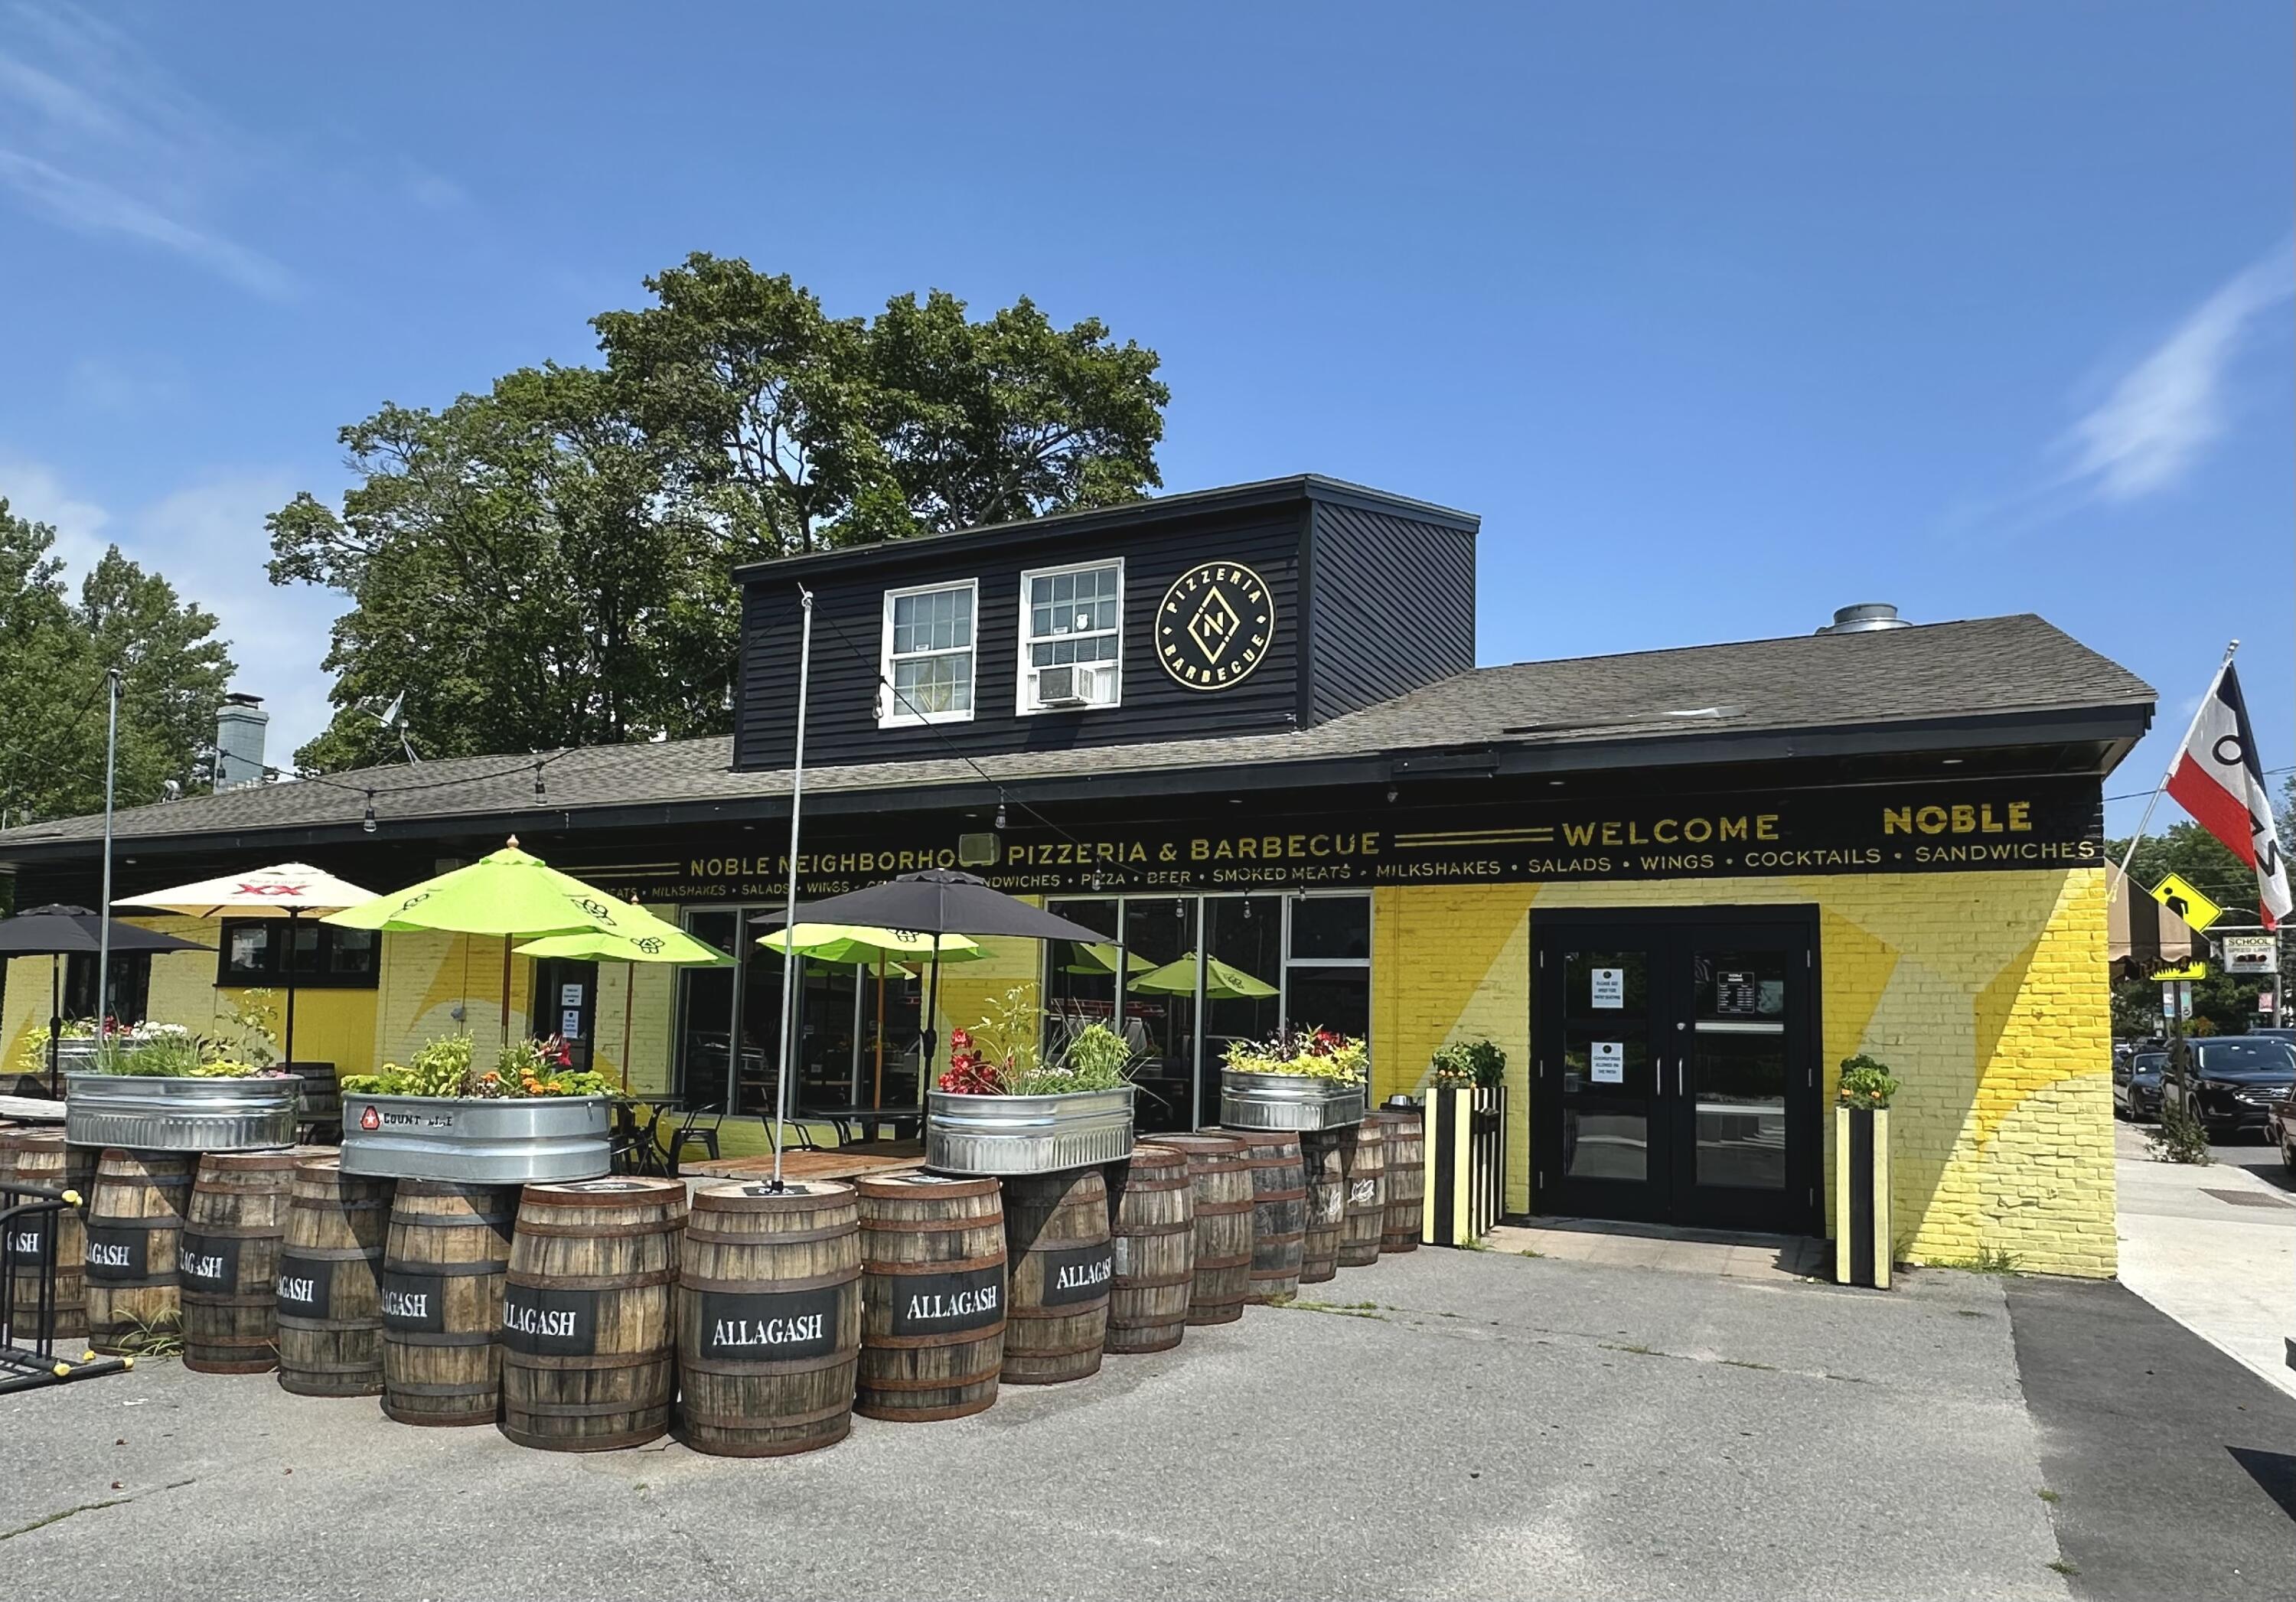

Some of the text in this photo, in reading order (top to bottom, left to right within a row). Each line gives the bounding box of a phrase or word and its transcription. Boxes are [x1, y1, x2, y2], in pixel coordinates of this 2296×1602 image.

[1166, 568, 1262, 614] PIZZERIA
[1164, 634, 1265, 683] BARBECUE
[1562, 814, 1779, 847] WELCOME
[1883, 801, 2033, 835] NOBLE
[690, 831, 1380, 877] NOBLE NEIGHBORHO PIZZERIA & BARBECUE
[1147, 870, 1191, 885] BEER
[1212, 866, 1287, 883] SMOKED
[1292, 864, 1352, 879] MEATS
[1376, 860, 1502, 878] MILKSHAKES
[1528, 856, 1612, 874] SALADS
[1640, 853, 1715, 871] WINGS
[1745, 848, 1882, 868] COCKTAILS
[1915, 841, 2095, 863] SANDWICHES
[652, 885, 726, 897] MILKSHAKES
[741, 882, 790, 896] SALADS
[807, 880, 850, 894] WINGS
[2228, 938, 2271, 946] SCHOOL
[906, 1285, 998, 1320] ALLAGASH
[713, 1313, 823, 1346] ALLAGASH
